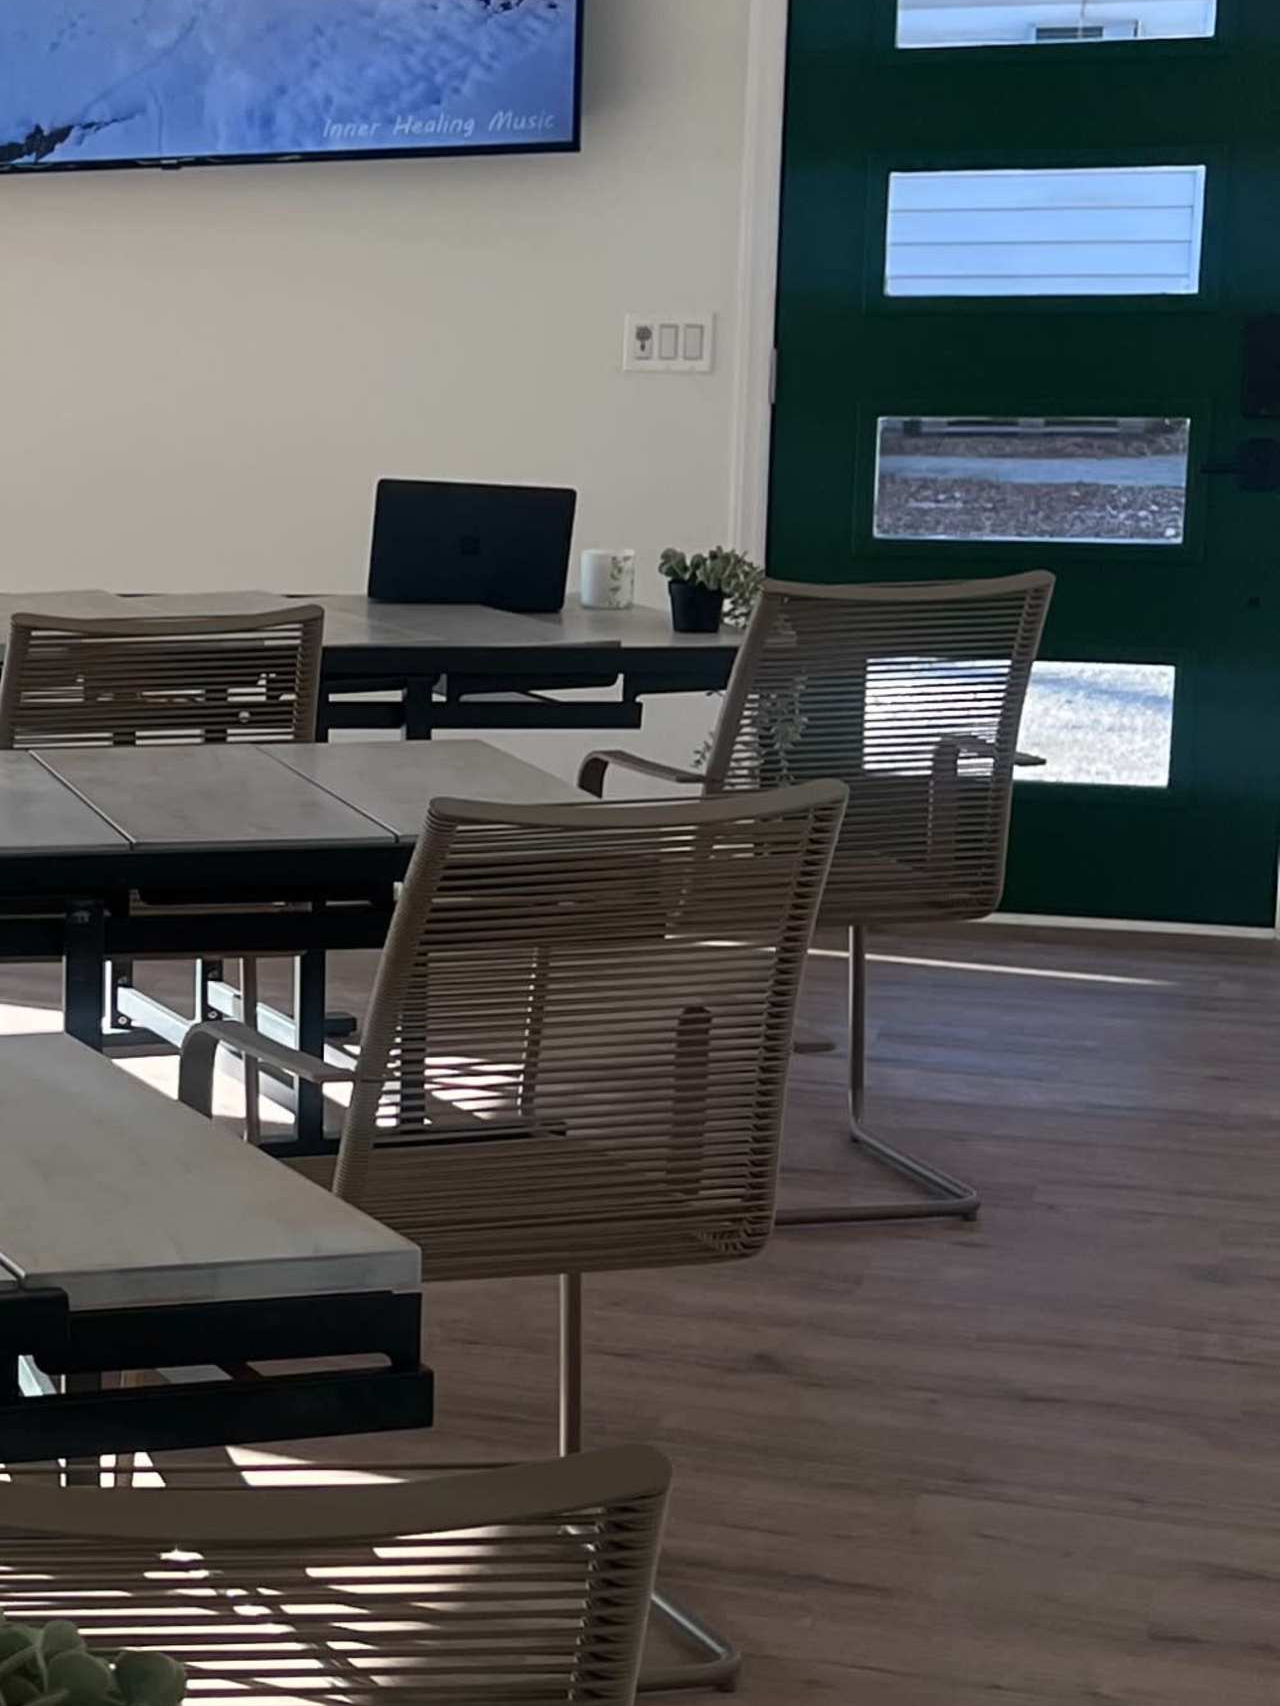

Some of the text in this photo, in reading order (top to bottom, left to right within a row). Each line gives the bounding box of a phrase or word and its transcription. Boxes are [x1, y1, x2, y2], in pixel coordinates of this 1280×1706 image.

[323, 110, 555, 138] Inner Healing Music
